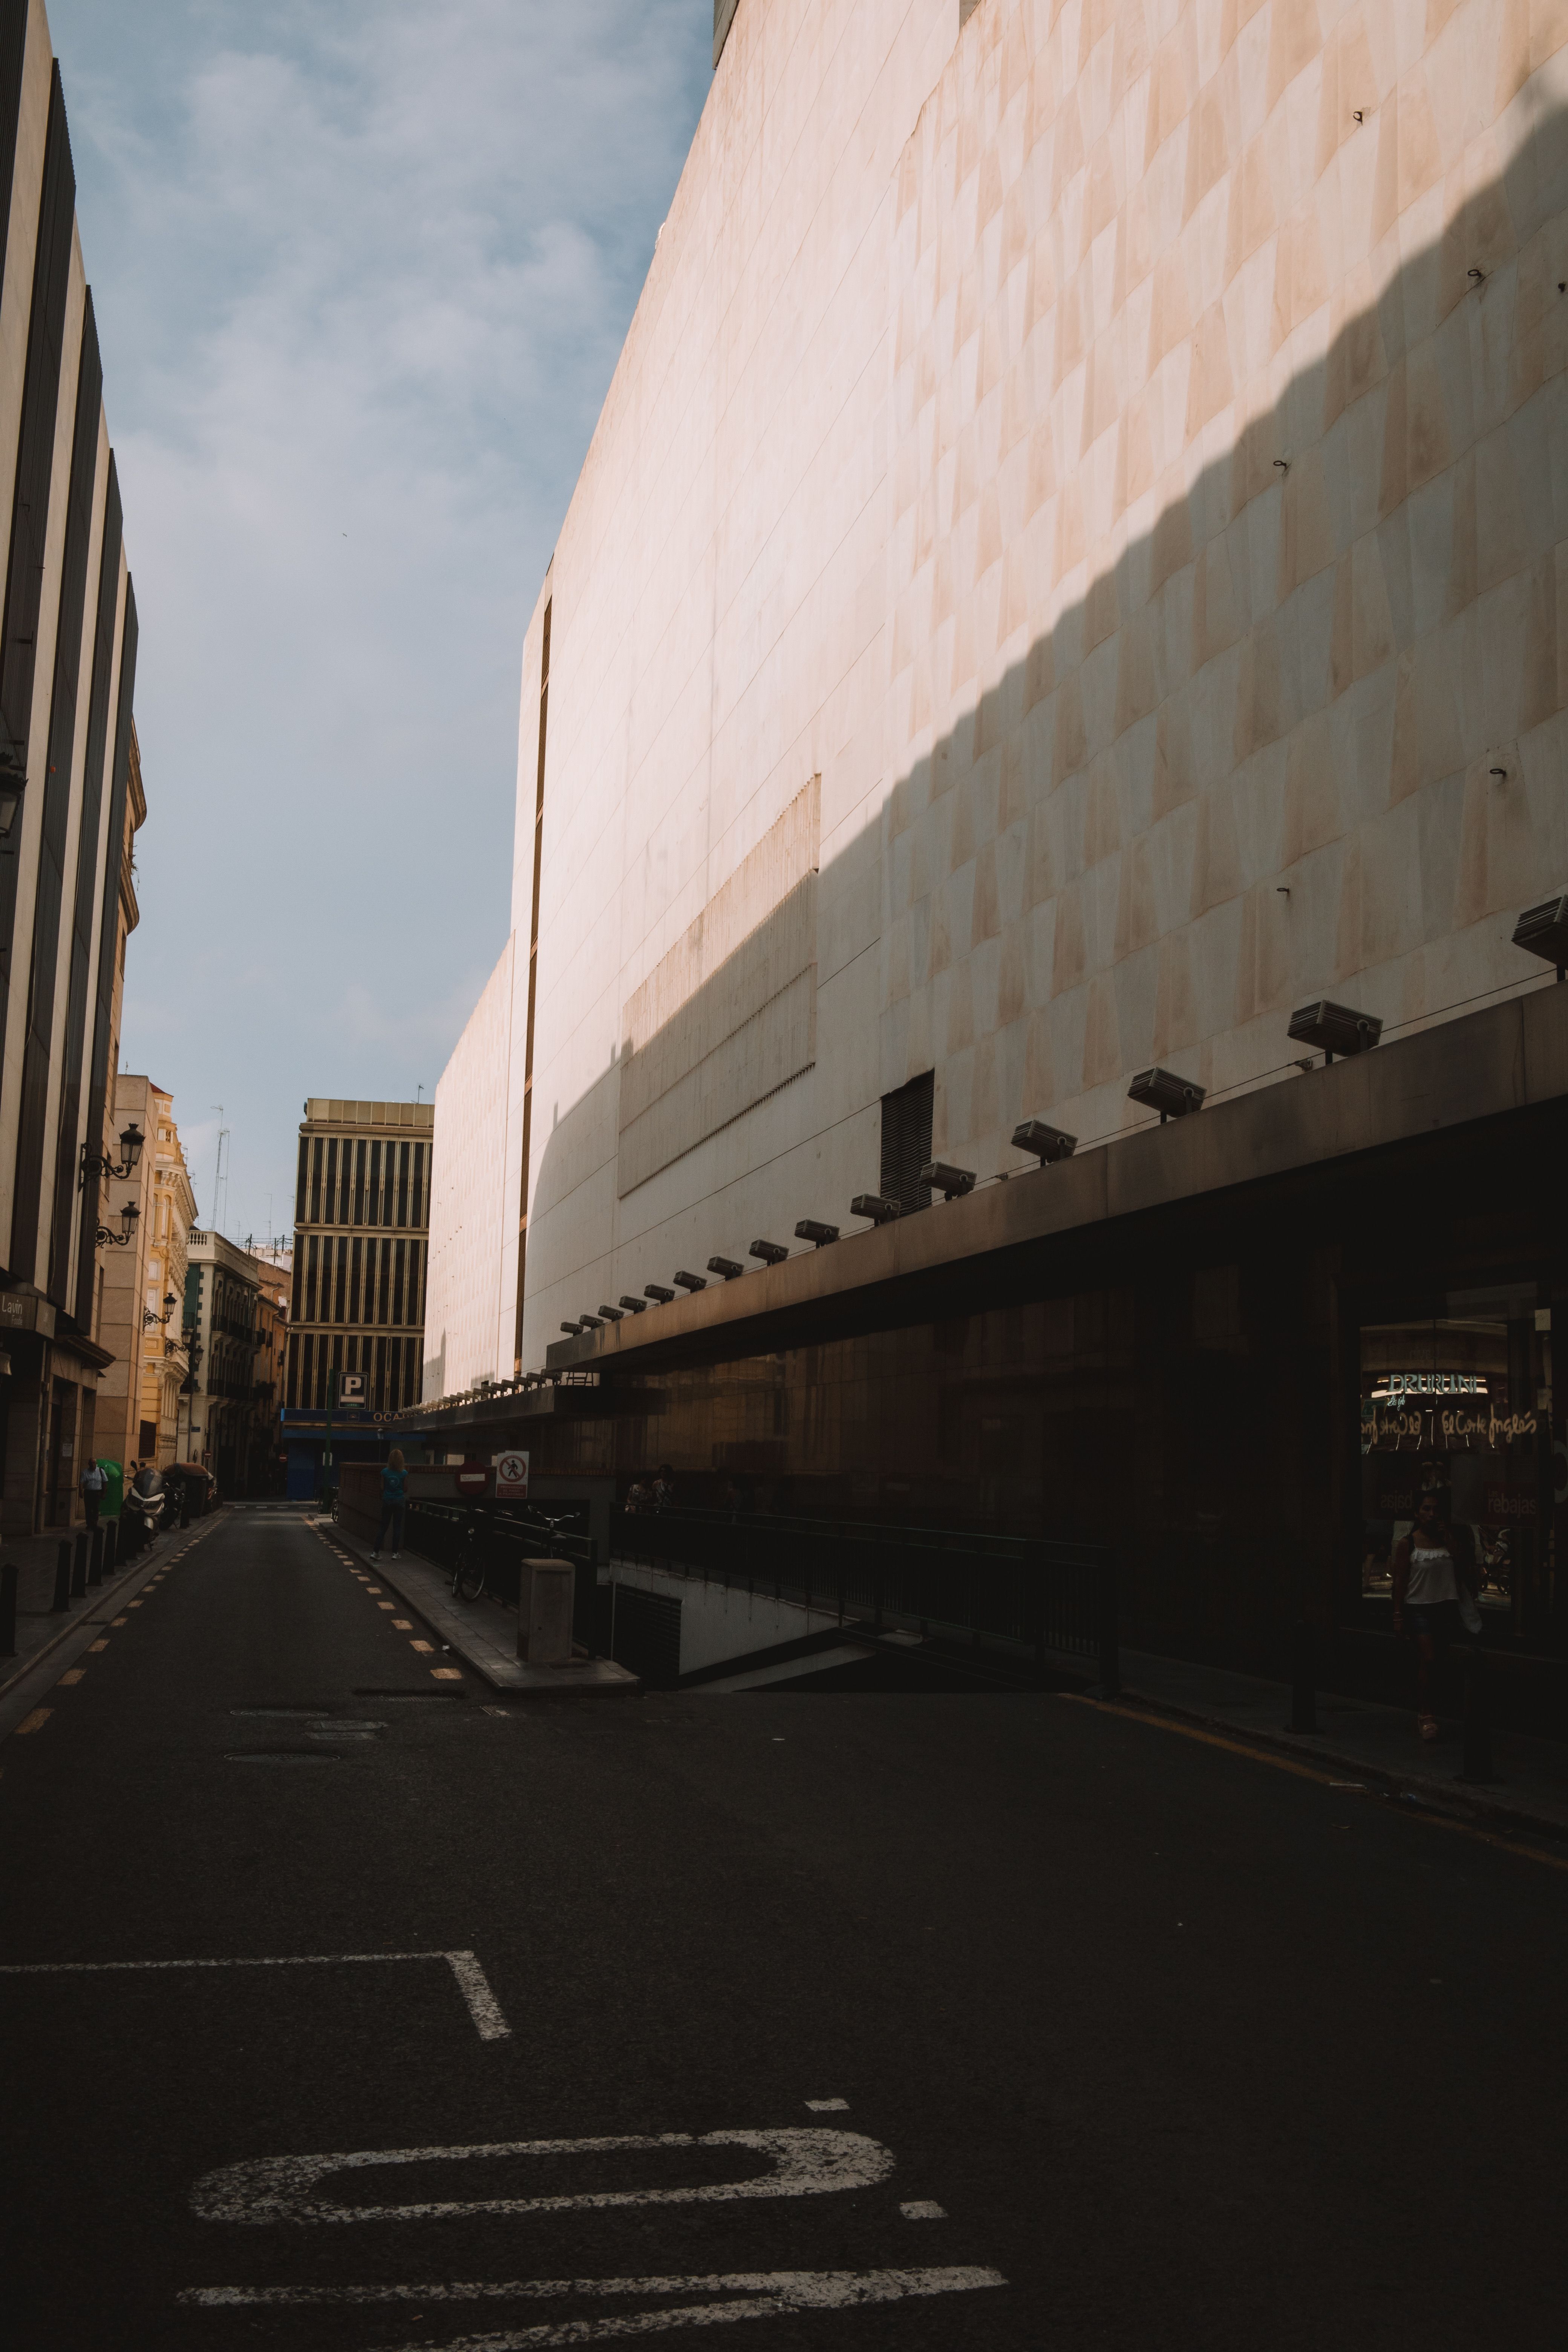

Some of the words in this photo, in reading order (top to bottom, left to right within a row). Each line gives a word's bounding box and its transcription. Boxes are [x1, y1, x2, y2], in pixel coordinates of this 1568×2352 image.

[2, 1295, 22, 1315] Lavin
[345, 1377, 361, 1394] P
[374, 1412, 404, 1422] OCA
[1441, 1410, 1455, 1435] El
[1455, 1411, 1487, 1436] Corte
[1488, 1403, 1537, 1444] Inglés
[1488, 1488, 1498, 1498] Las
[1488, 1493, 1536, 1519] rebajas
